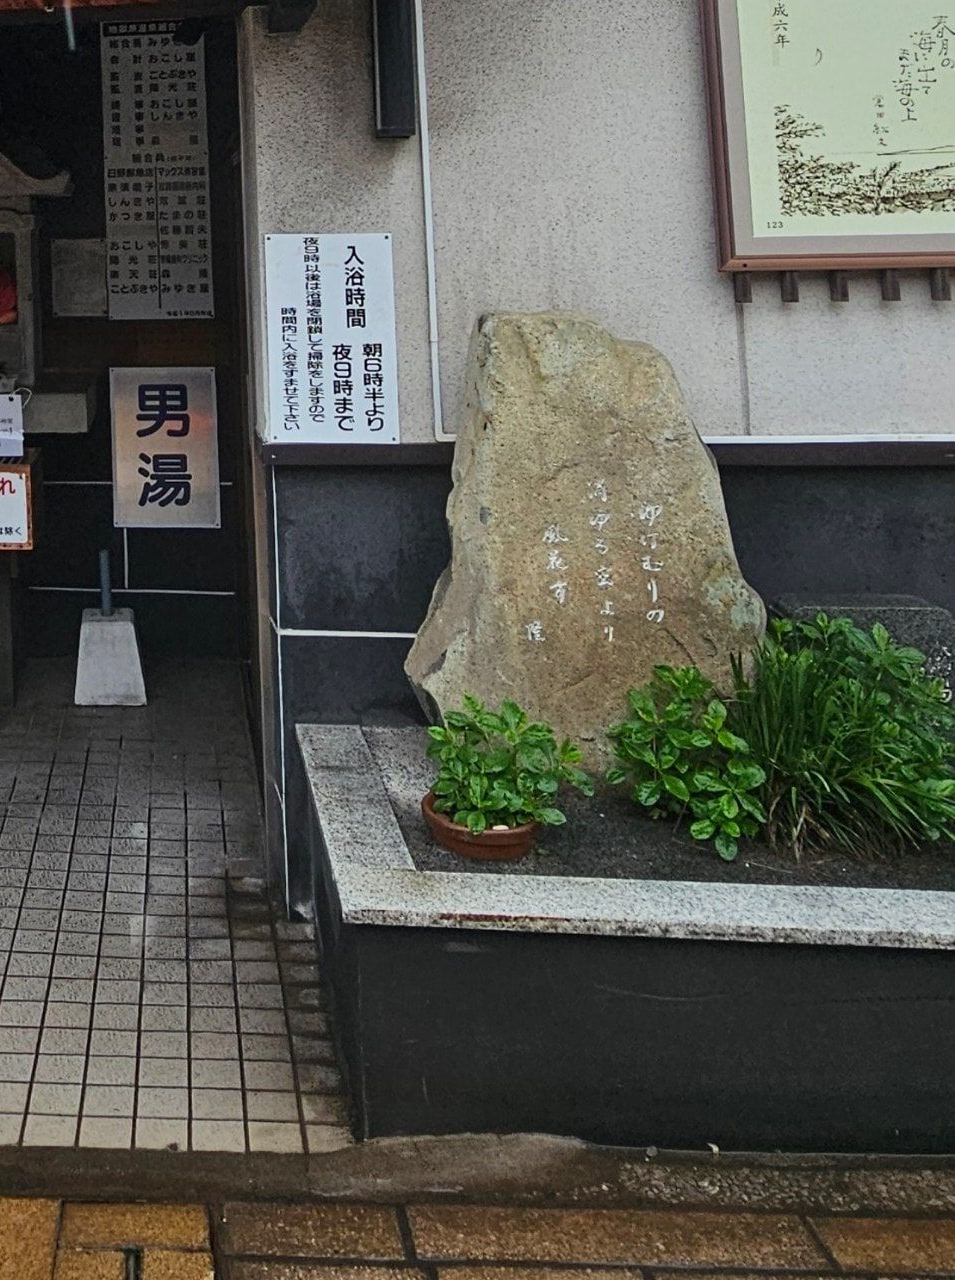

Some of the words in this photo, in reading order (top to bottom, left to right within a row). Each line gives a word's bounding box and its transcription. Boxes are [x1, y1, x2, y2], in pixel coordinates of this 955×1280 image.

[766, 221, 784, 229] 123
[302, 237, 325, 423] 夜9時以後は浴場を閉鎖して掃除をしますので
[343, 245, 366, 329] 入浴時間
[281, 307, 300, 431] 時間内に入浴をすませて下さい
[332, 344, 354, 432] 夜9時まで
[362, 343, 384, 432] 朝6時半より
[136, 384, 193, 508] 男湯
